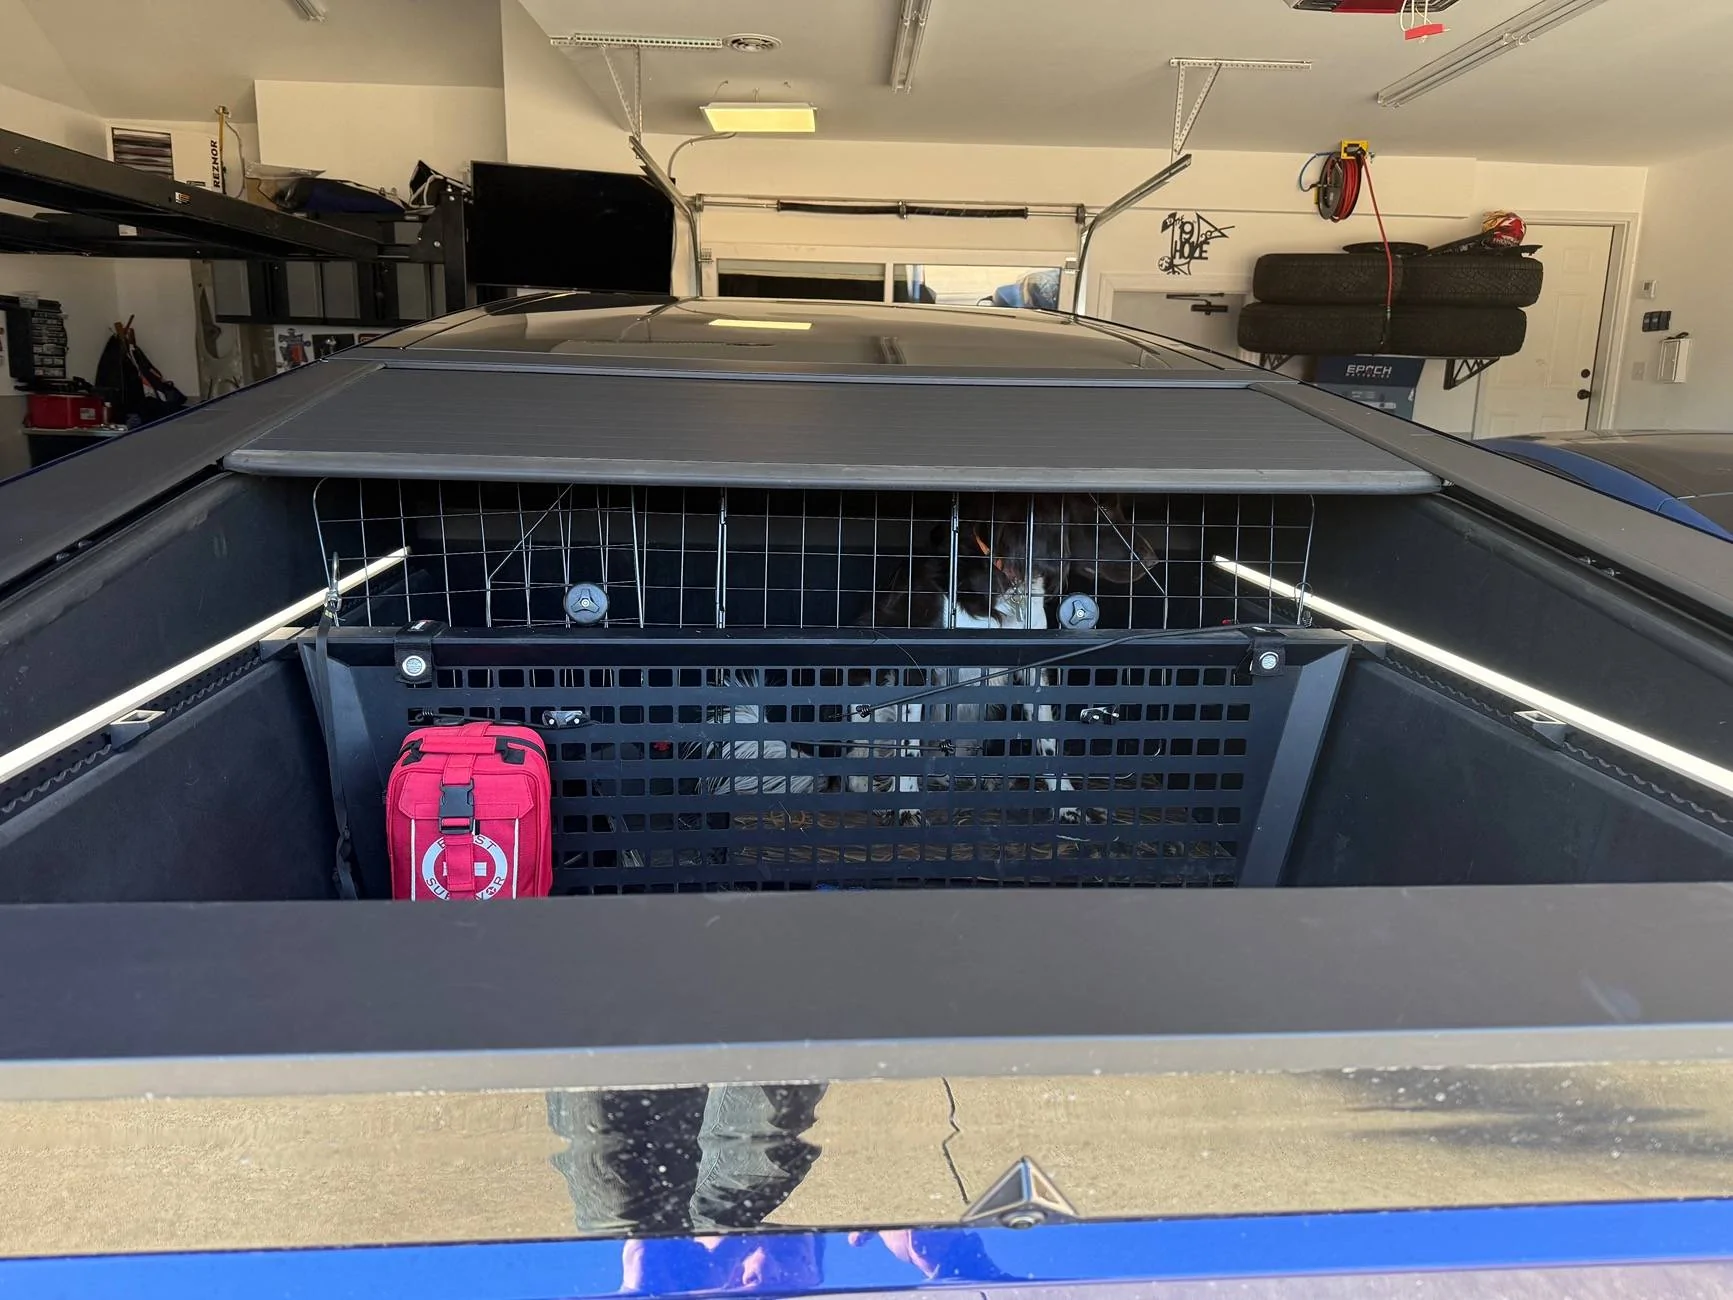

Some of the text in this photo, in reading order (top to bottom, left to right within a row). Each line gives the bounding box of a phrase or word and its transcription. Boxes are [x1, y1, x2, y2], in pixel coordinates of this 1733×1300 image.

[210, 139, 221, 189] REZNOR
[1173, 239, 1210, 260] HOLE
[1346, 364, 1392, 375] EPOCH
